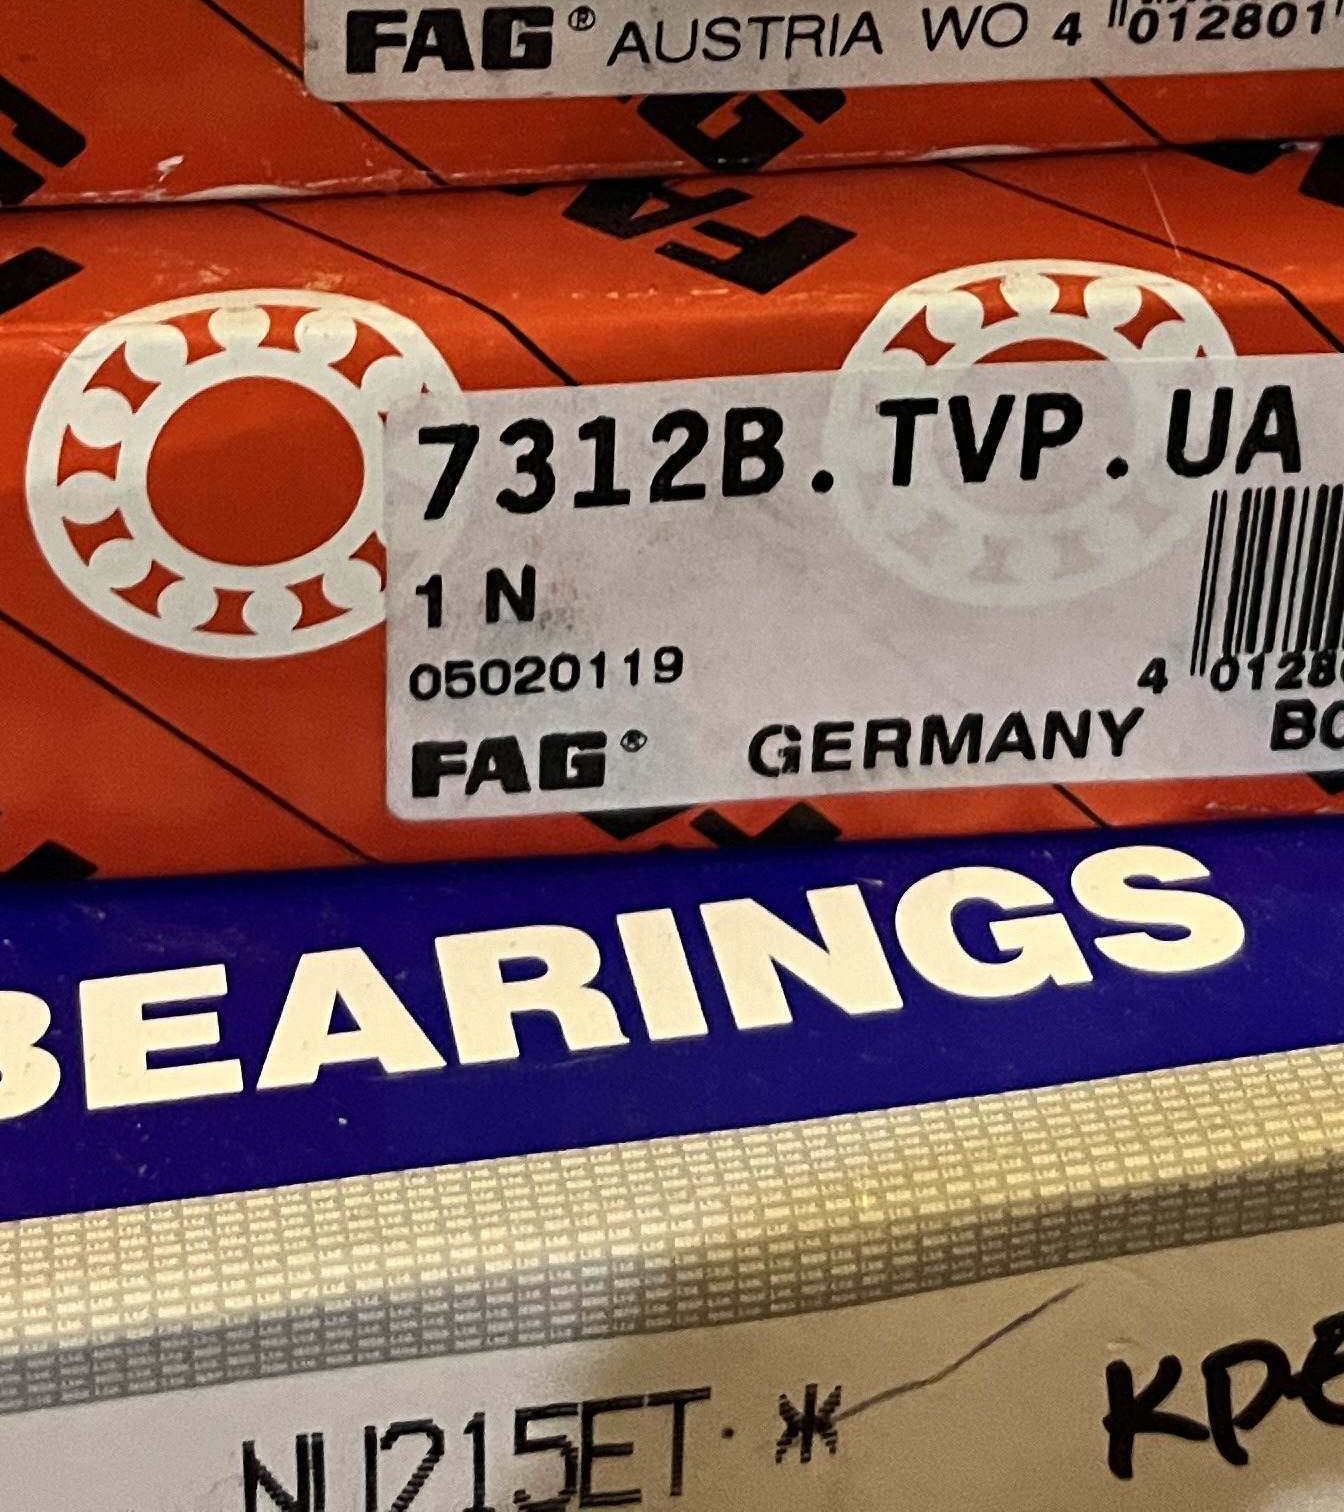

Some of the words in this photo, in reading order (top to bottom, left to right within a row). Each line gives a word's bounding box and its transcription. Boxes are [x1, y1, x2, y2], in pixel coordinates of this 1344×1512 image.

[607, 12, 884, 68] AUSTRIA
[922, 3, 1029, 51] WO
[1053, 10, 1082, 47] 4
[1128, 0, 1327, 45] 012801
[415, 574, 443, 628] 1
[485, 565, 537, 622] N
[409, 645, 684, 701] 05020119
[1138, 658, 1168, 693] 4
[747, 707, 1144, 778] GERMANY
